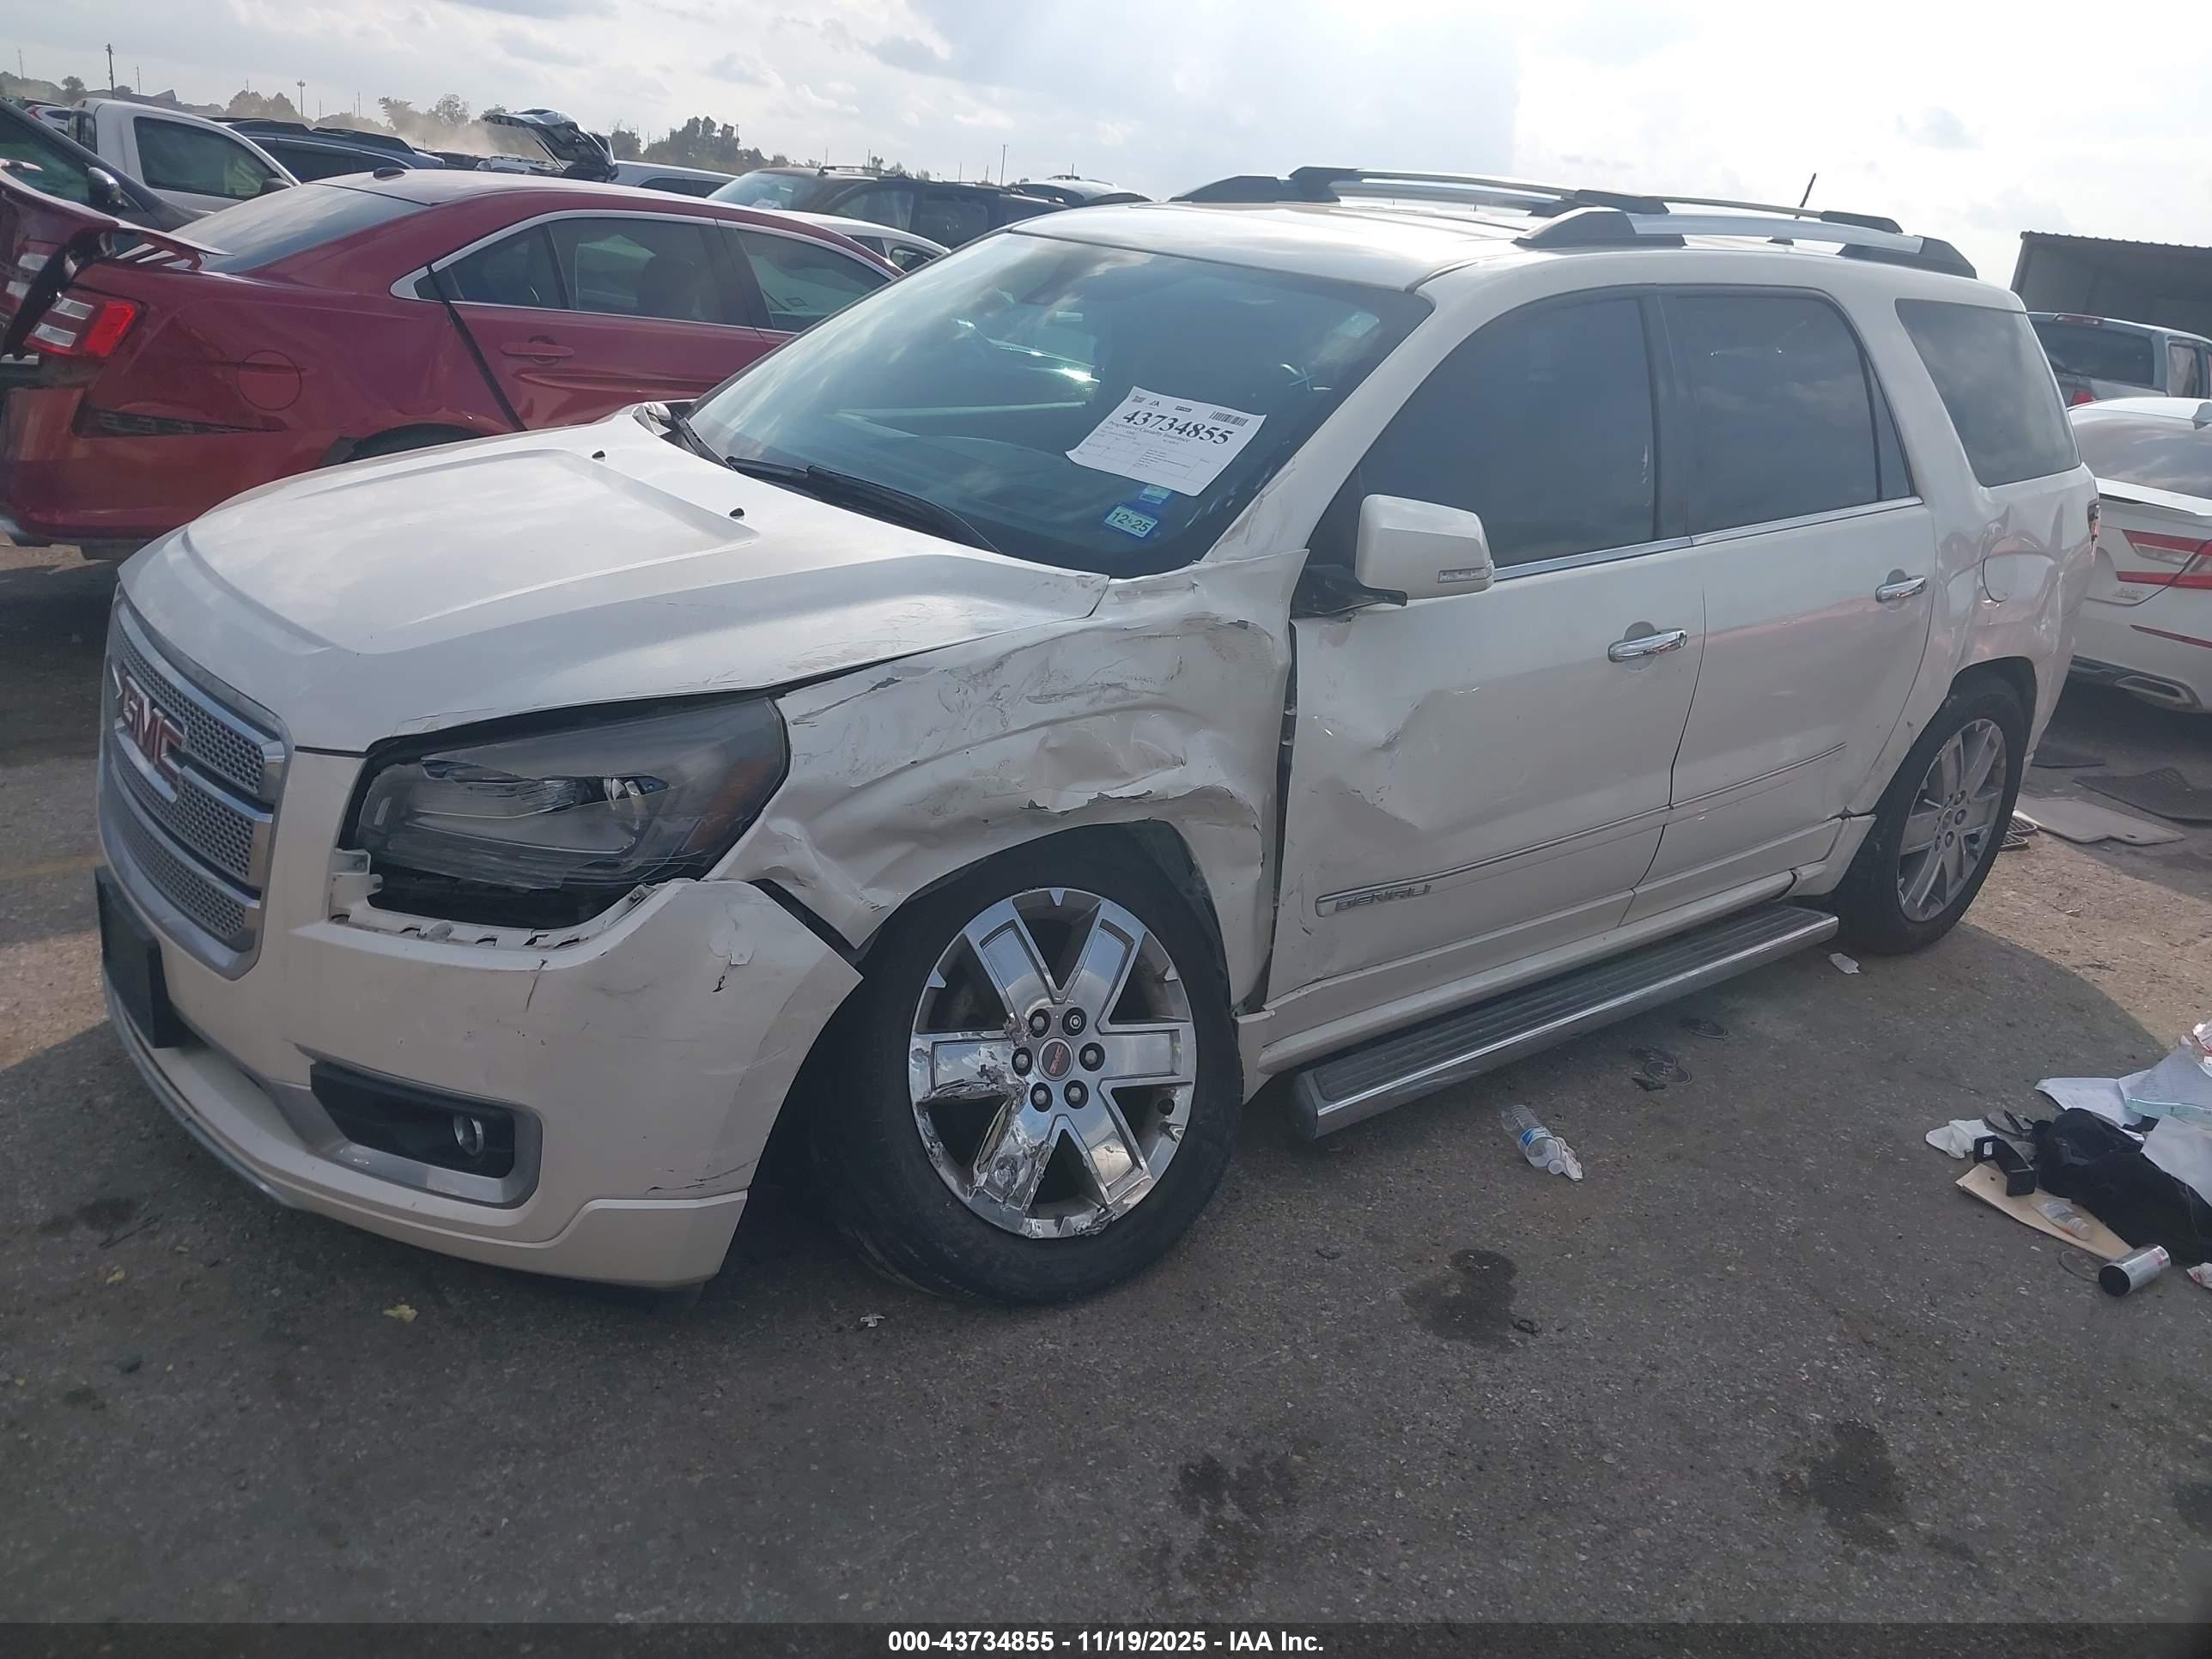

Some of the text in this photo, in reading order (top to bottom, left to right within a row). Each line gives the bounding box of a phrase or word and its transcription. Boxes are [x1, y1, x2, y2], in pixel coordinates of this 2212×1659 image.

[1123, 410, 1234, 445] 43734855
[122, 675, 188, 785] GMC
[1334, 884, 1431, 912] DENALI
